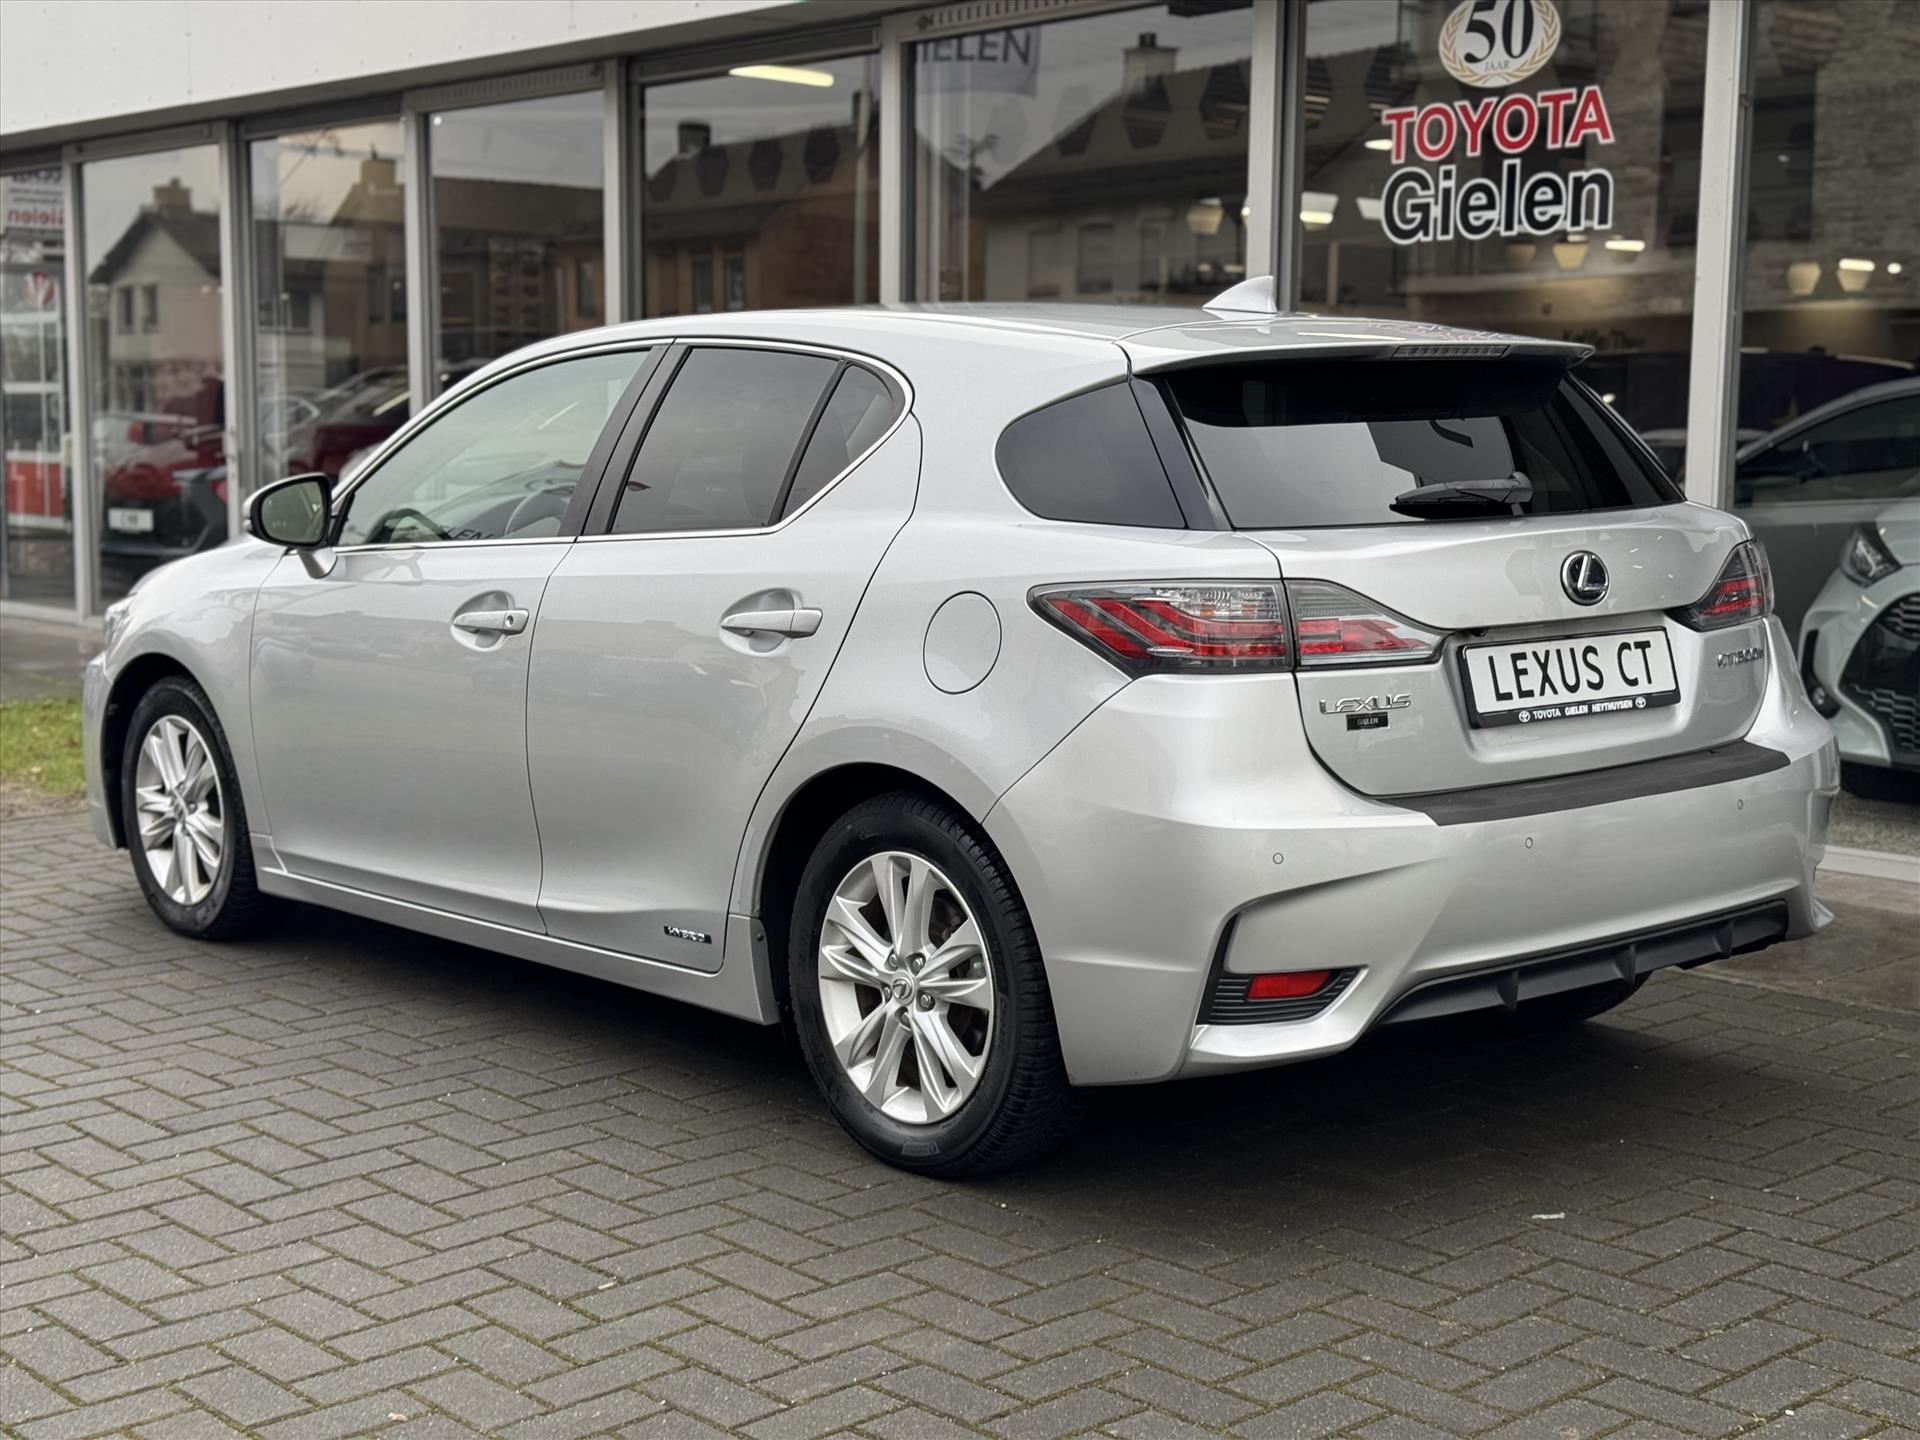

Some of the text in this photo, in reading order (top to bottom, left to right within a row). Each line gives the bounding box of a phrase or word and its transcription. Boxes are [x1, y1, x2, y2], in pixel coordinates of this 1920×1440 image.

[1464, 0, 1534, 63] 50
[1484, 60, 1511, 73] JAAR
[1382, 86, 1615, 164] TOYOTA
[1381, 158, 1615, 245] Gielen
[1488, 640, 1652, 702] LEXUS CT
[1319, 694, 1411, 715] LEXUS
[1533, 708, 1561, 720] TOYOTA
[1565, 705, 1589, 716] GIELEN
